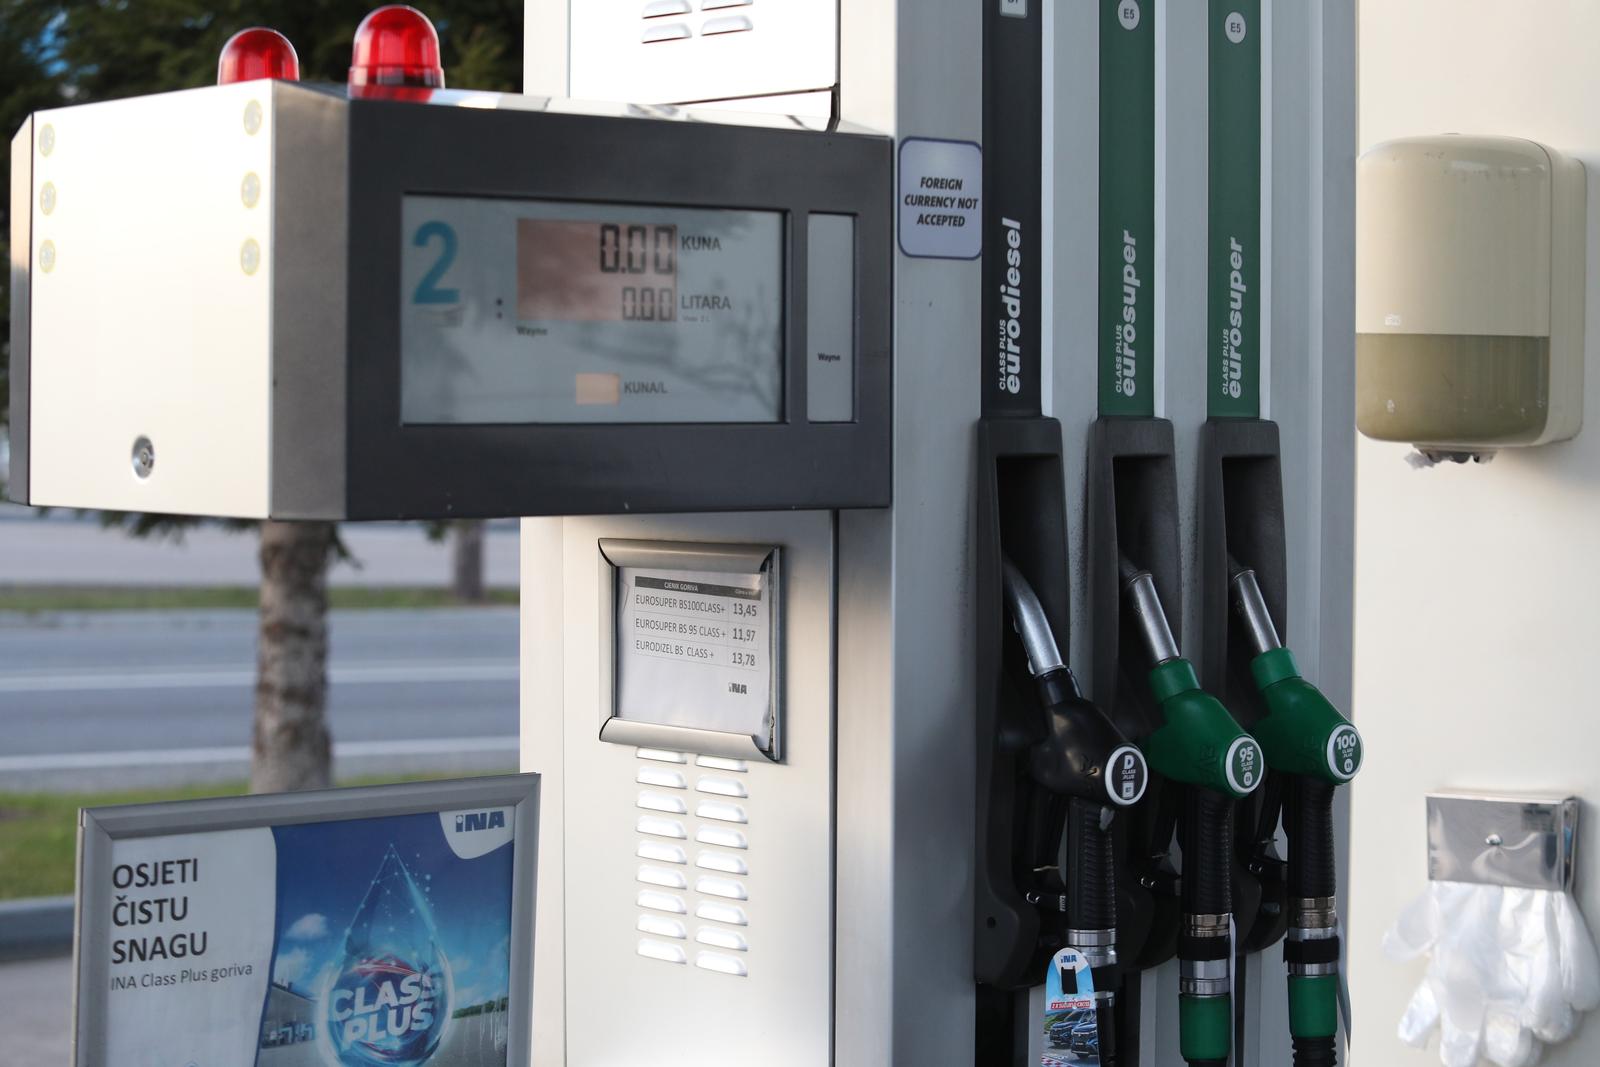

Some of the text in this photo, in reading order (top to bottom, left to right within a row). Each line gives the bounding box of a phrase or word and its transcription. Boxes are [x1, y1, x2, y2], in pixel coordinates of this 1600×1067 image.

[1123, 8, 1135, 20] E5
[1230, 22, 1242, 33] E5
[920, 176, 963, 190] FOREIGN
[904, 194, 979, 209] CURRENCY NOT
[916, 213, 966, 227] ACCEPTED
[600, 224, 722, 275] 0.00 KUNA
[411, 220, 462, 305] 2
[622, 287, 732, 322] 0.00 LITARA
[1000, 217, 1021, 394] eurodiesel
[1122, 230, 1141, 396] eurosuper
[1229, 237, 1246, 398] eurosuper
[516, 326, 548, 337] Wayne
[817, 352, 841, 363] Wayne
[624, 381, 668, 395] KUNA/L
[635, 594, 678, 608] EUROSUPER
[733, 603, 757, 618] 13,45
[635, 618, 677, 632] EUROSUPER
[679, 623, 687, 634] BS
[688, 625, 698, 635] 95
[699, 626, 720, 638] CLASS
[732, 628, 756, 642] 11,97
[636, 640, 674, 654] EURODIZEL
[687, 646, 708, 659] CLASS
[732, 652, 756, 666] 13,78
[1239, 746, 1253, 762] 95
[1336, 734, 1356, 750] 100
[1124, 755, 1134, 769] D
[111, 858, 199, 890] OSJETI
[111, 895, 190, 927] ČISTU
[111, 931, 208, 965] SNAGU
[110, 962, 253, 991] INA Class Plus goriva
[332, 970, 443, 1023] CLASS
[343, 1000, 436, 1046] PLUS
